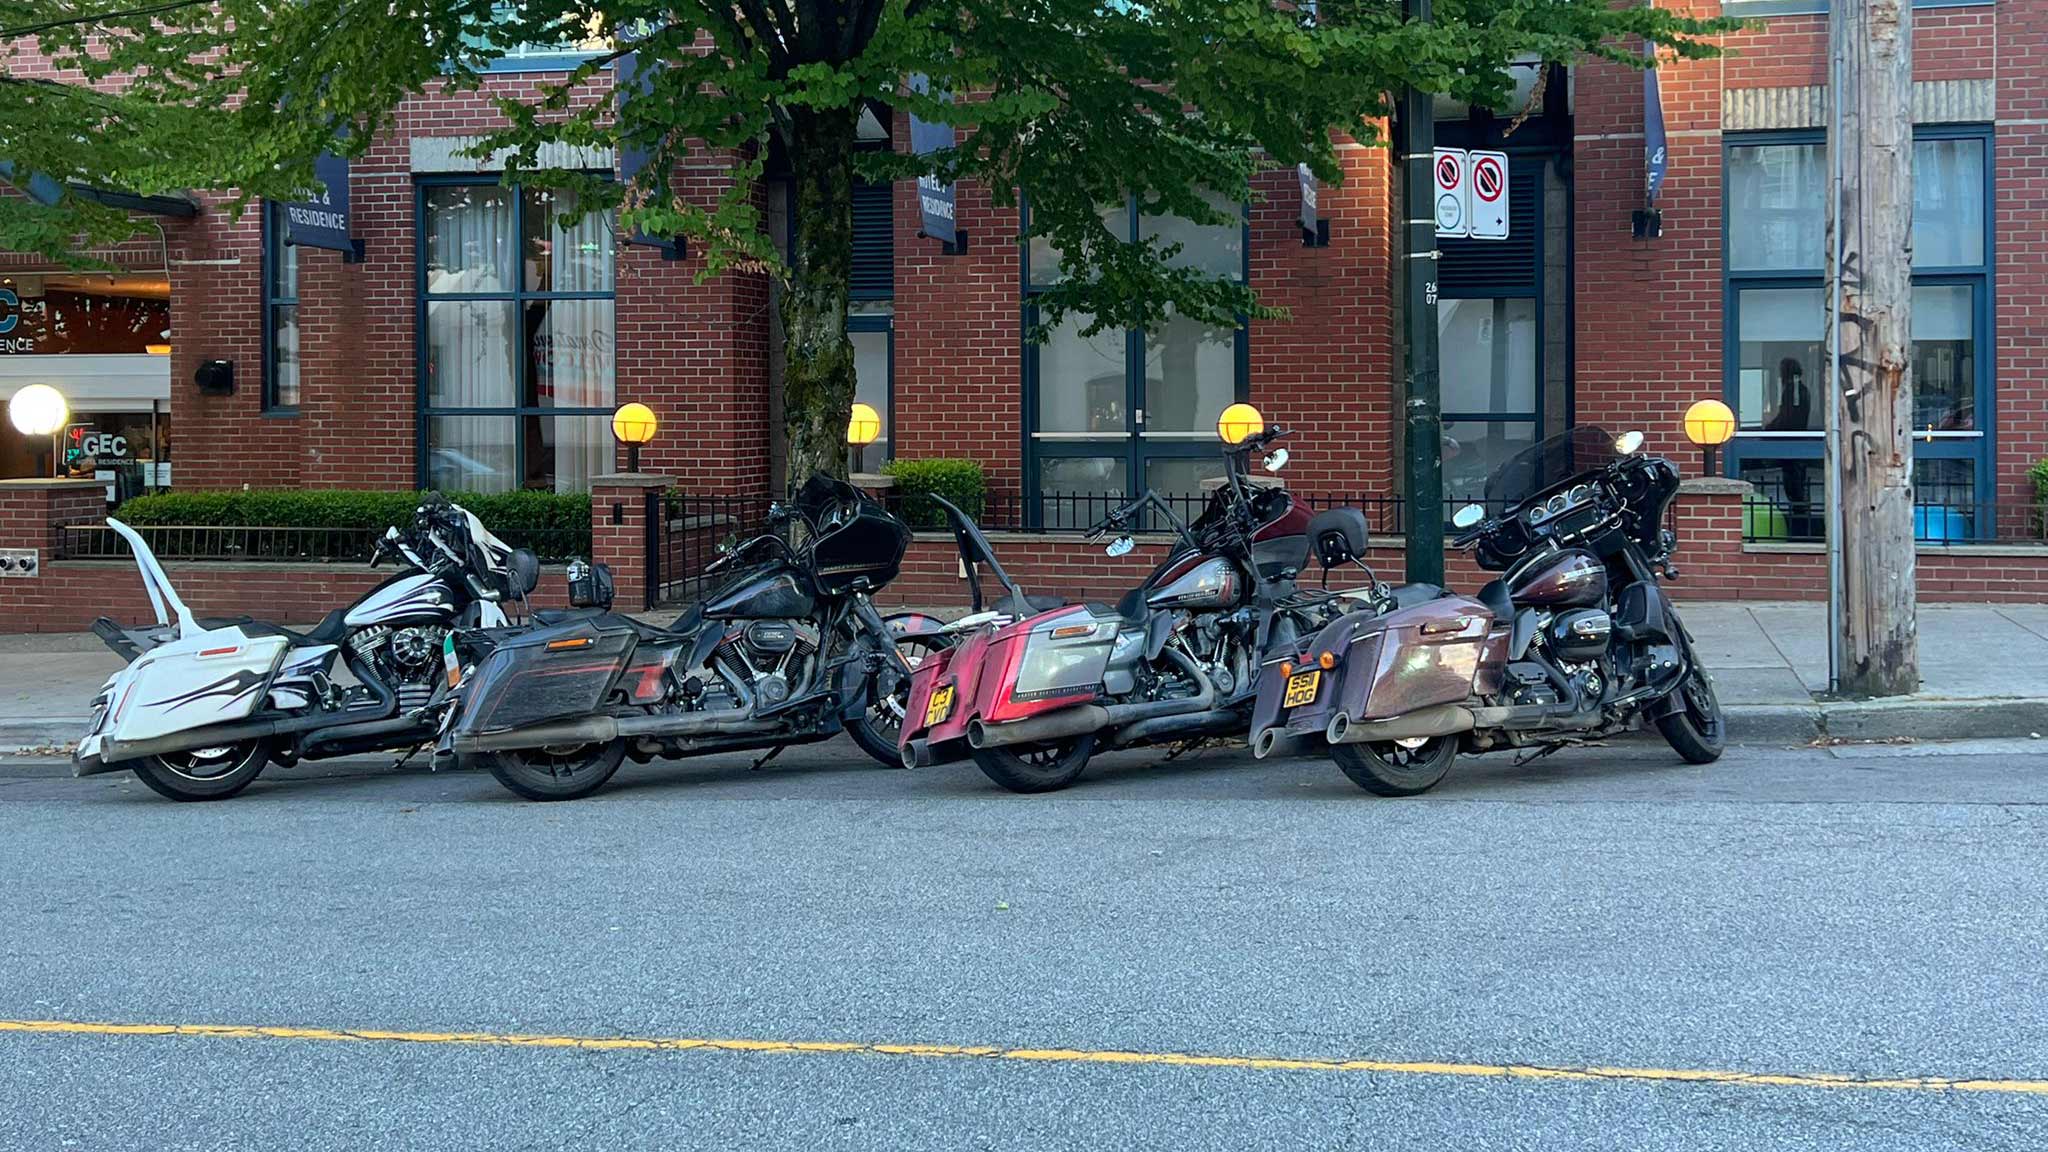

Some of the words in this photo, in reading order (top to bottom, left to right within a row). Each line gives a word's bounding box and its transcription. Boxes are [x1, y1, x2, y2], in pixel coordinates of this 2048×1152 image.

[922, 195, 953, 220] RESIDENCE
[289, 206, 346, 230] RESIDENCE
[1425, 282, 1437, 293] 26
[1426, 294, 1437, 305] 07
[83, 433, 127, 457] GEC
[1286, 688, 1314, 705] HOG
